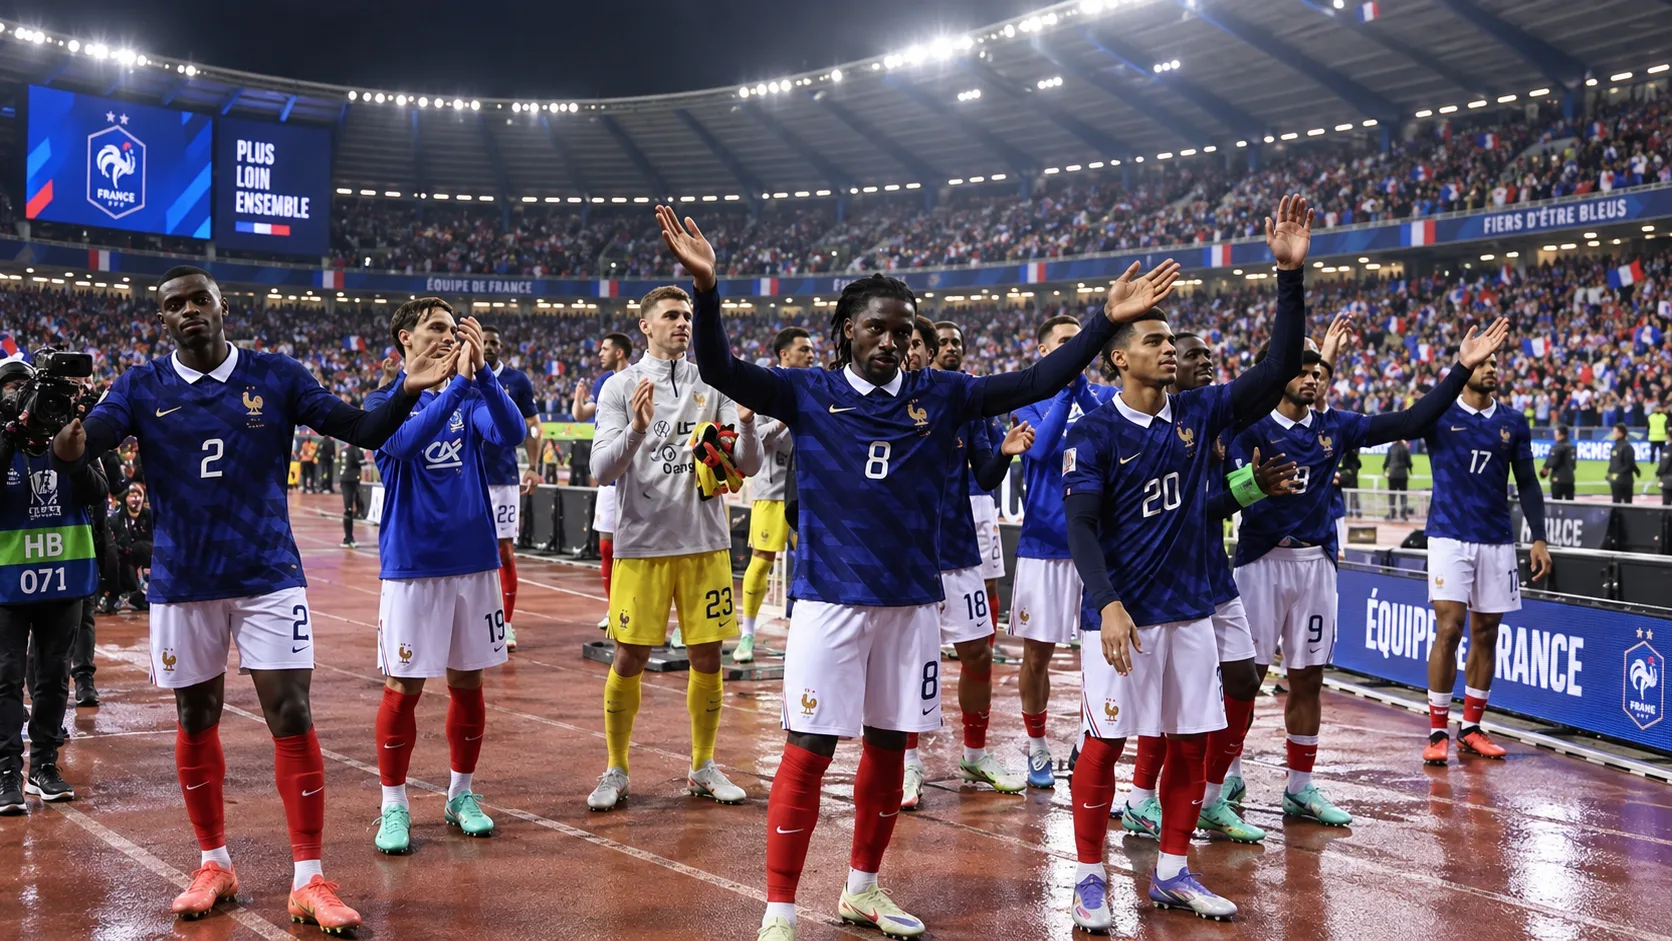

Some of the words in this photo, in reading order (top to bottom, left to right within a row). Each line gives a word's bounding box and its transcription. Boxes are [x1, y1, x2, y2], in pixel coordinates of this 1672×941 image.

[236, 139, 275, 165] PLUS
[236, 165, 271, 190] LOIN
[97, 188, 135, 203] FRANCE
[235, 191, 310, 219] ENSEMBLE
[1483, 213, 1523, 234] FIERS
[1579, 199, 1627, 222] BLEUS
[426, 277, 470, 292] ÉQUIPE
[472, 280, 485, 292] DE
[488, 280, 532, 294] FRANCE
[200, 438, 224, 478] 2
[864, 440, 891, 479] 8
[1469, 449, 1492, 474] 17
[1142, 471, 1182, 518] 20
[24, 533, 63, 559] HB
[20, 567, 67, 594] 071
[705, 586, 733, 619] 23
[963, 590, 987, 620] 18
[292, 604, 309, 641] 2
[484, 609, 506, 643] 19
[1308, 614, 1323, 643] 9
[1495, 623, 1585, 697] RANCE
[921, 660, 938, 701] 8
